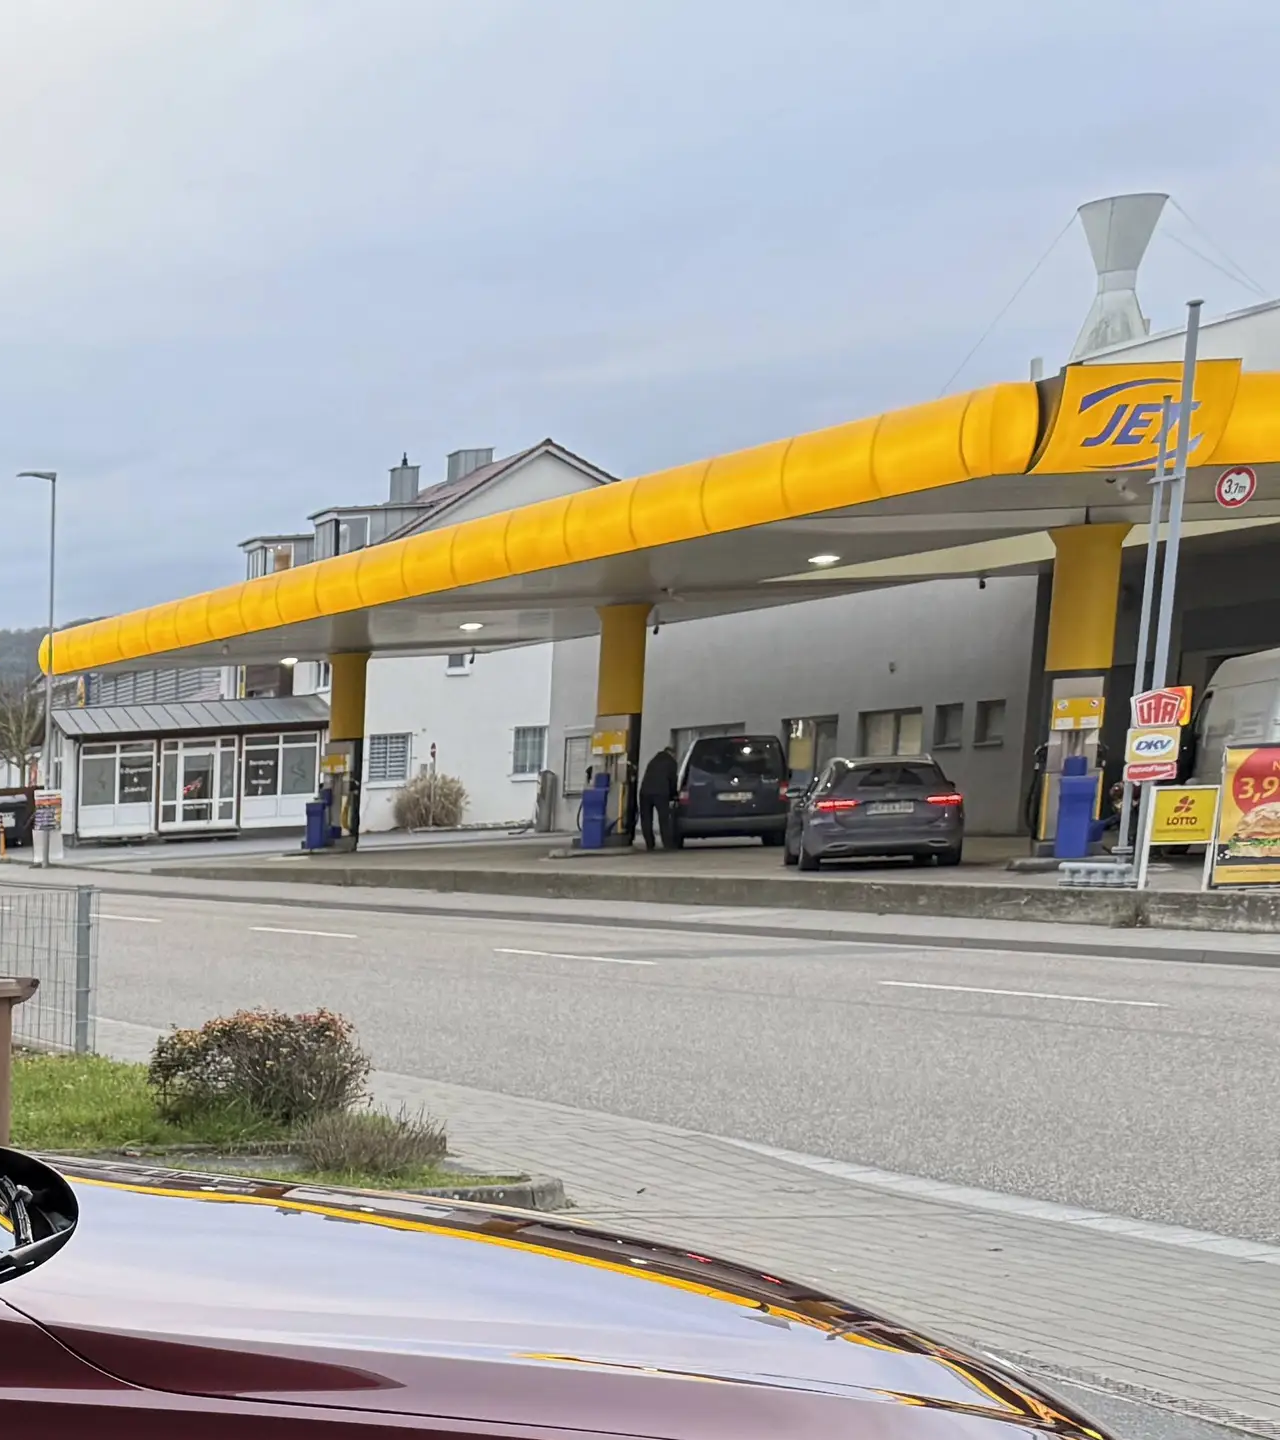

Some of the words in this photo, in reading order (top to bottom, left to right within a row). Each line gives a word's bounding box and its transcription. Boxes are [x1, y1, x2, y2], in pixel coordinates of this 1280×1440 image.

[1080, 402, 1202, 447] JET
[1135, 739, 1172, 751] DKV
[1166, 816, 1197, 826] LOTTO
